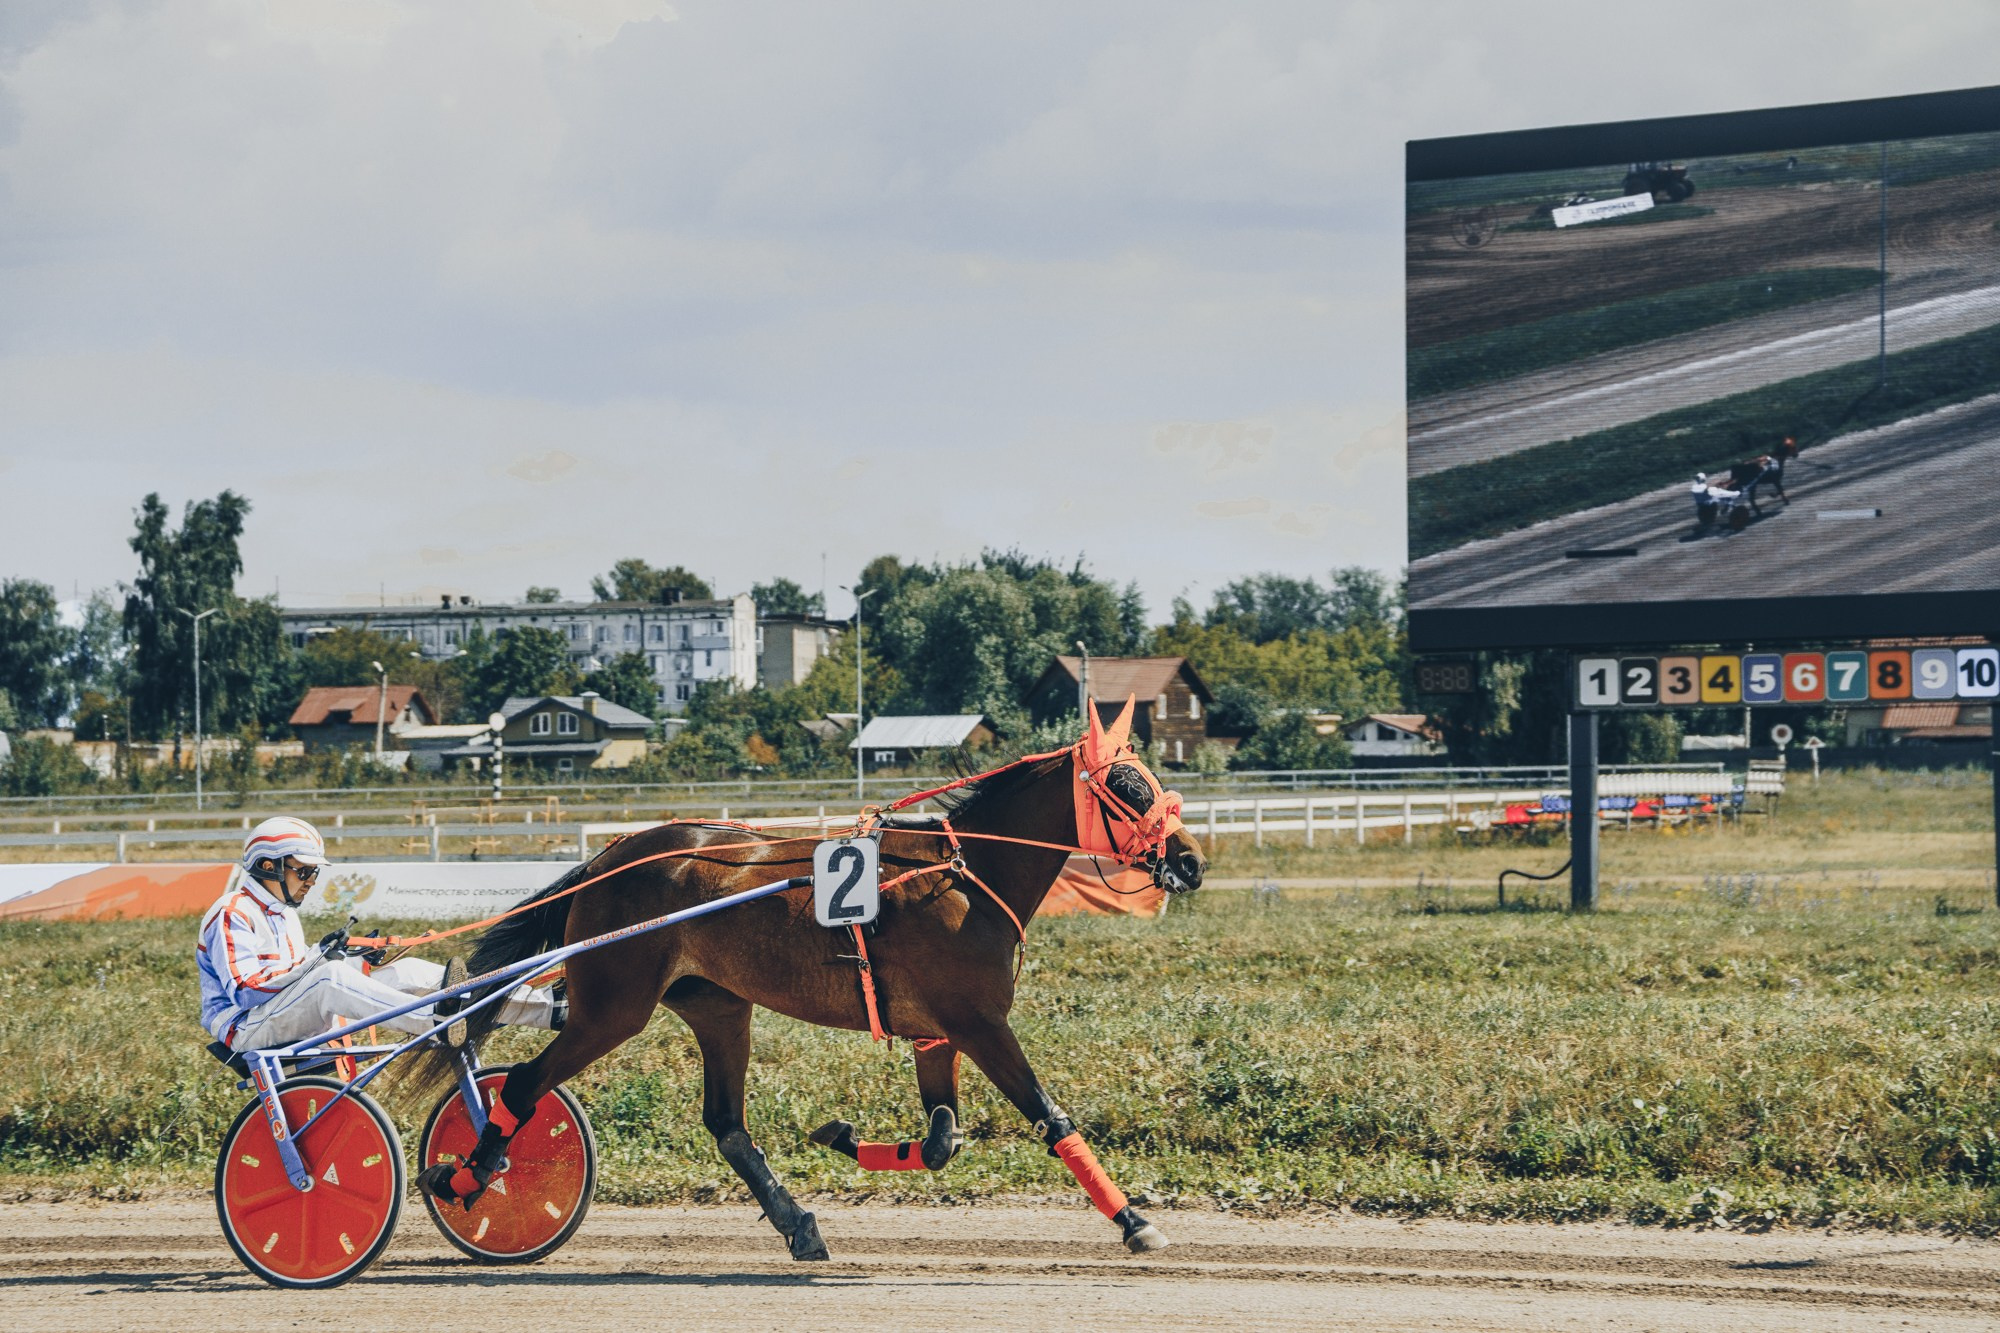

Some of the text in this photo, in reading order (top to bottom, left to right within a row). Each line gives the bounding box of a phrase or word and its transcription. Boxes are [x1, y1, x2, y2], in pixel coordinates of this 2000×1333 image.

[1589, 657, 1997, 696] 1 2 3 4 5 6 7 8 9 10
[386, 886, 470, 897] Министерство
[473, 886, 530, 896] сельского
[827, 845, 866, 920] 2
